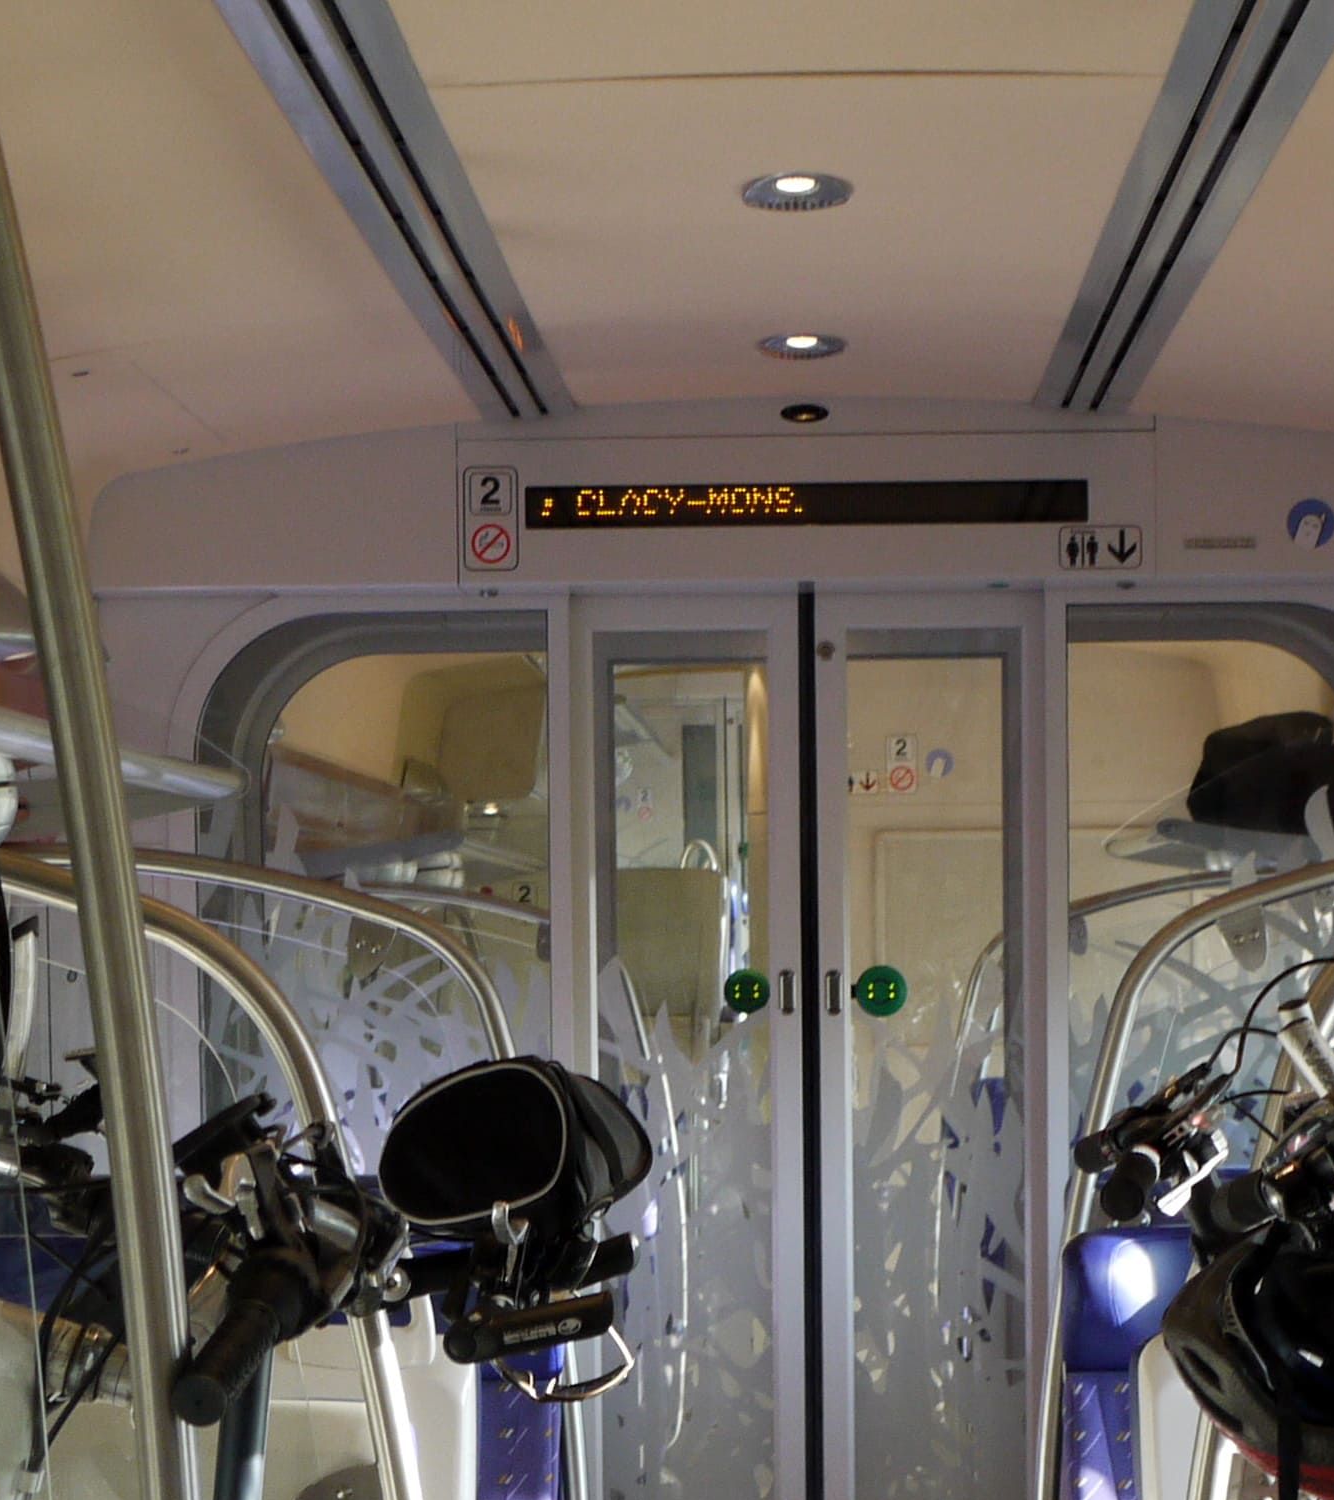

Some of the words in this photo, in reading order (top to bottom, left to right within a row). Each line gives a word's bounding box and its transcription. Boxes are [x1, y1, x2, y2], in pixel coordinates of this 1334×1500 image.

[480, 476, 500, 505] 2
[894, 738, 907, 757] 2
[518, 885, 532, 903] 2
